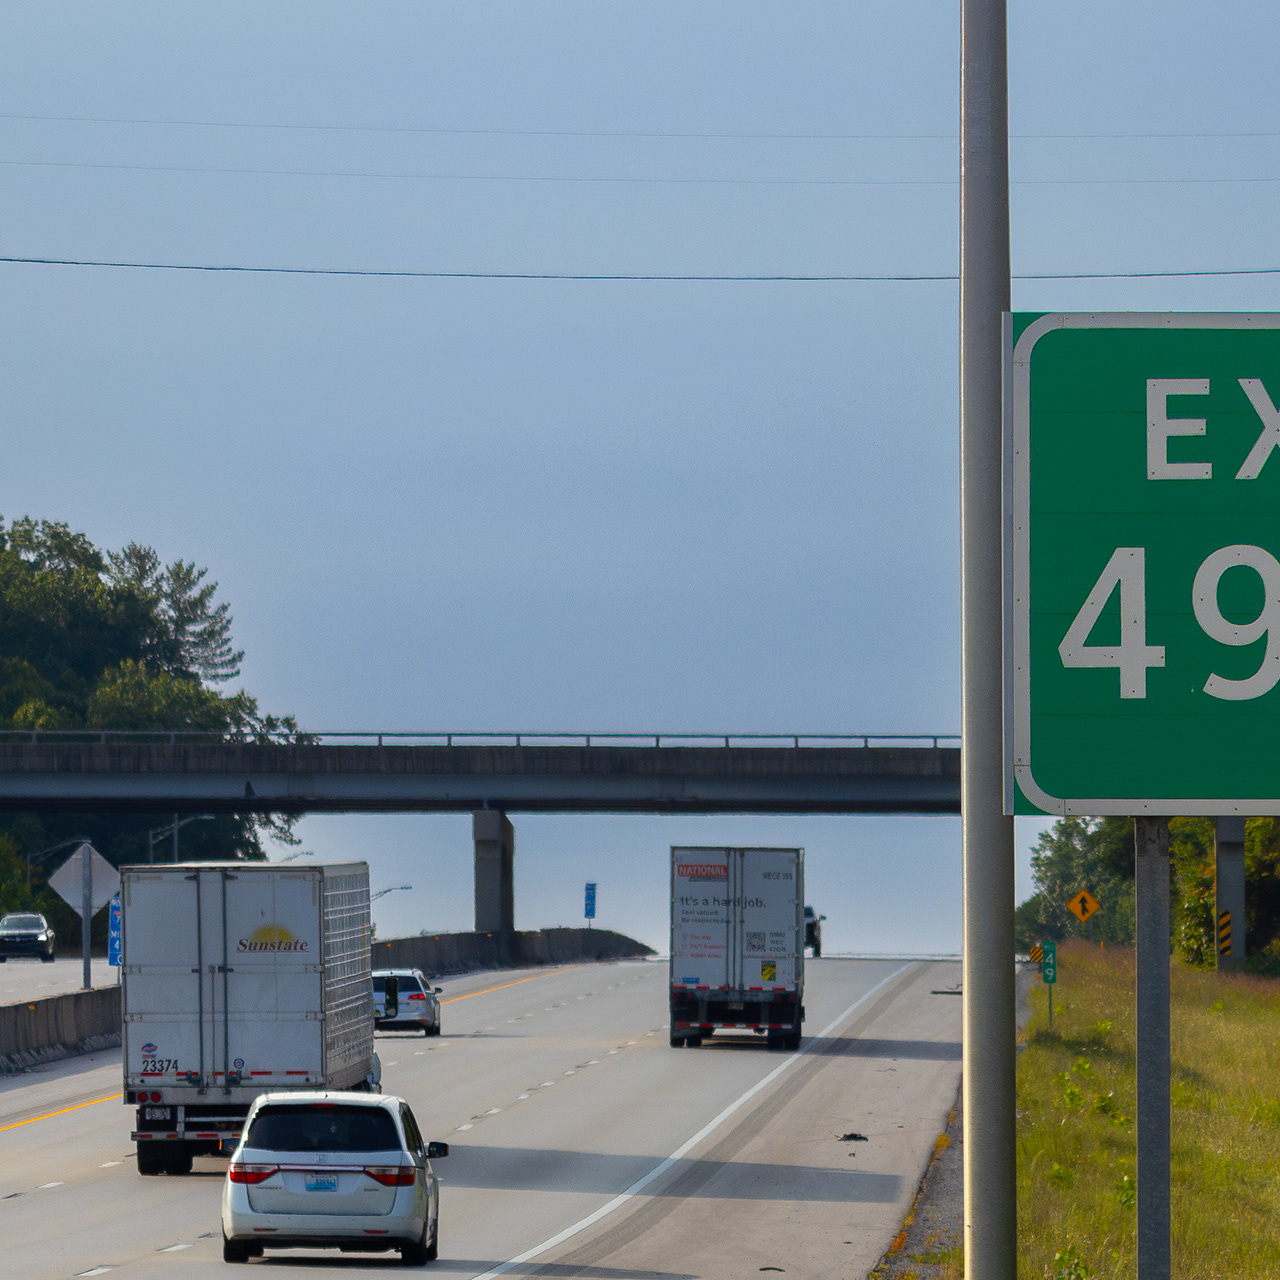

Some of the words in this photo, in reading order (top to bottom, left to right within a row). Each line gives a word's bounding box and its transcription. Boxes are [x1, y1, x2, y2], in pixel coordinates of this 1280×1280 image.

[679, 866, 726, 876] NATIONAL
[681, 896, 699, 906] It's
[712, 896, 740, 907] hard
[741, 897, 767, 909] job.
[236, 937, 309, 953] Sunstate
[142, 1059, 179, 1073] 23374
